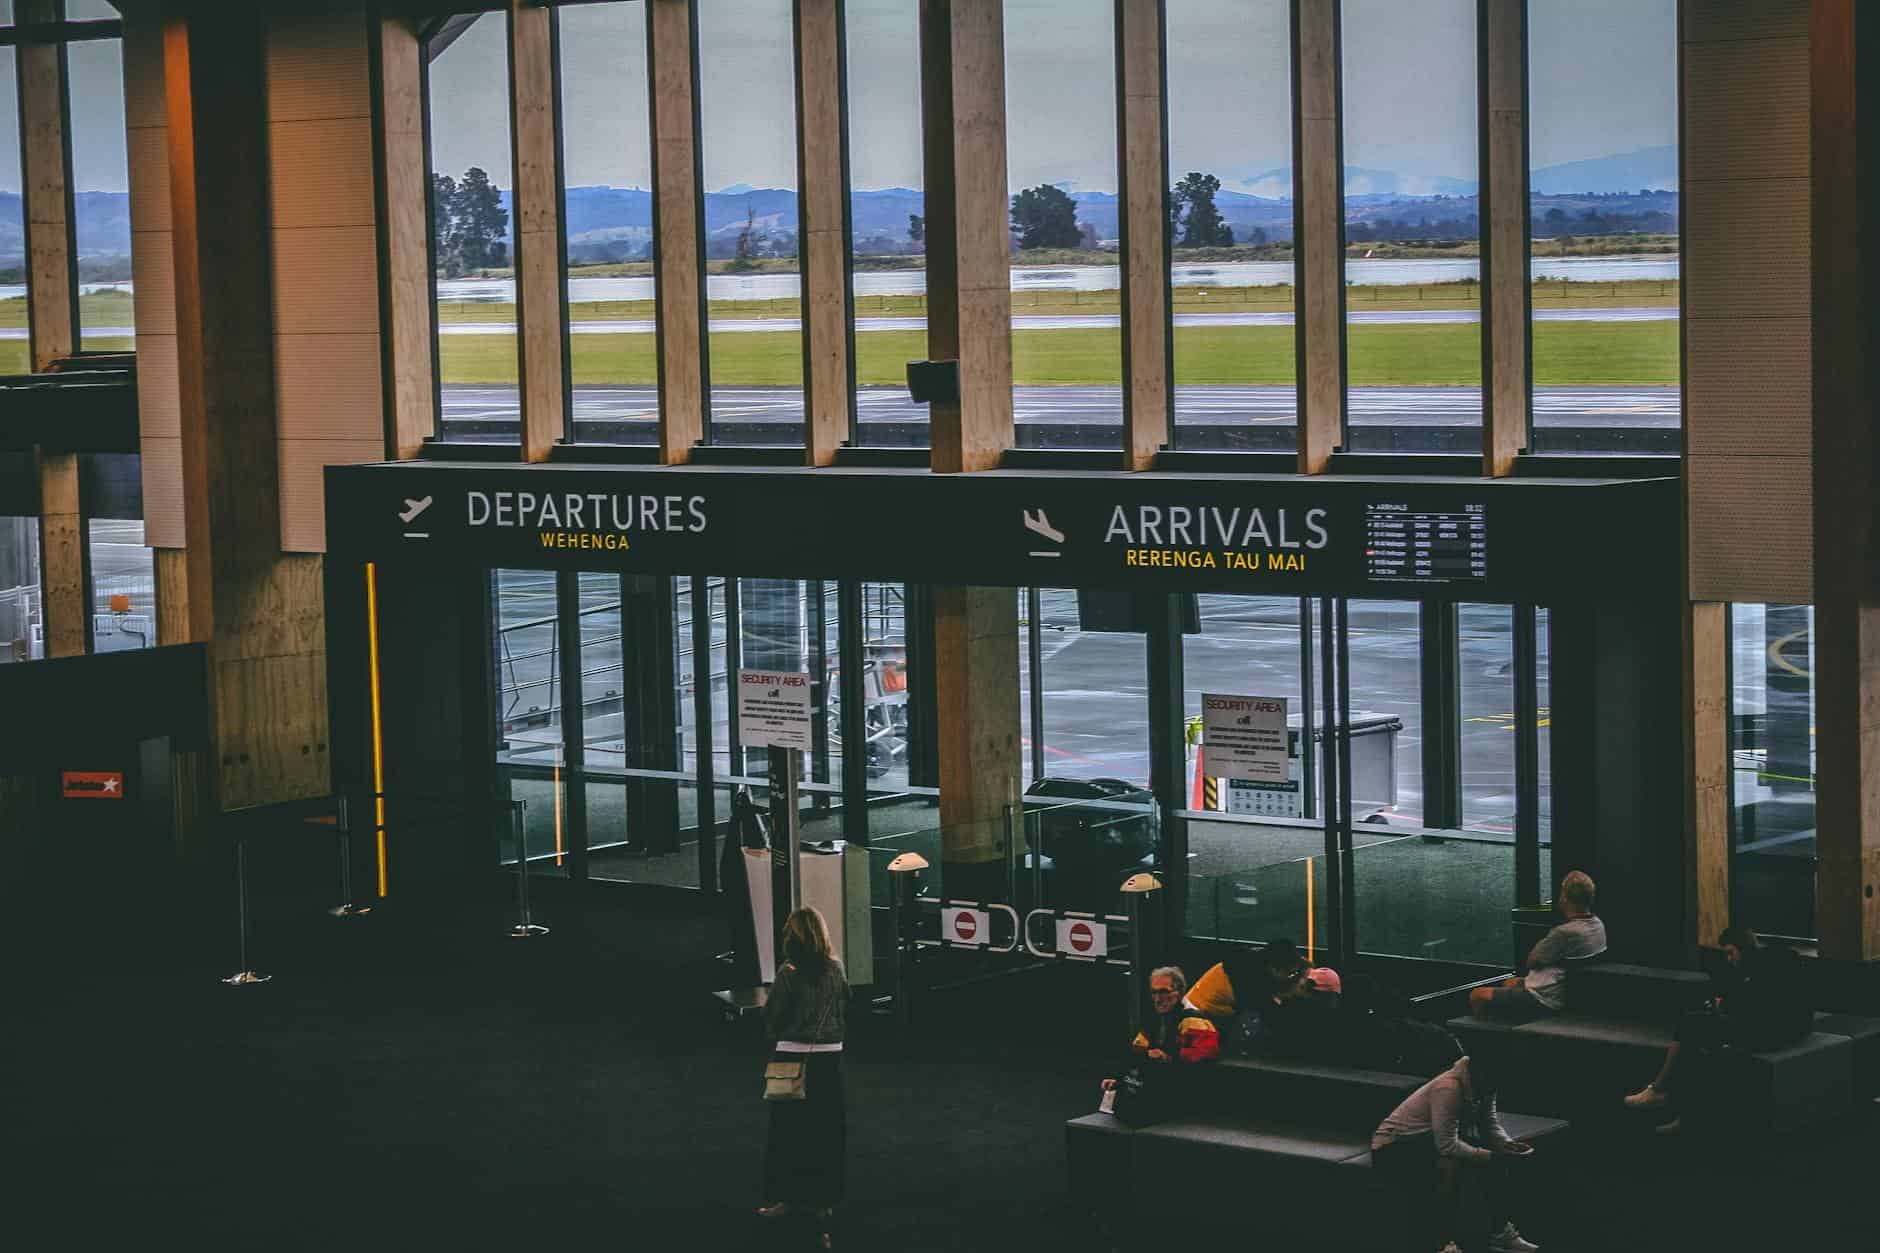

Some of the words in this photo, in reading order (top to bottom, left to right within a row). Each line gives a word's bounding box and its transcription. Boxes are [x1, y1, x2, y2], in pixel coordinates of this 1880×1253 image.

[467, 491, 707, 533] DEPARTURES
[1104, 505, 1328, 549] ARRIVALS
[540, 532, 630, 550] WEHENGA
[1127, 549, 1216, 569] RERENGA
[1224, 552, 1260, 570] TAU
[1268, 553, 1305, 571] MAI
[742, 673, 781, 686] SECURITY
[783, 676, 806, 687] AREA
[1208, 700, 1252, 711] SECURITY
[1255, 702, 1281, 713] AREA
